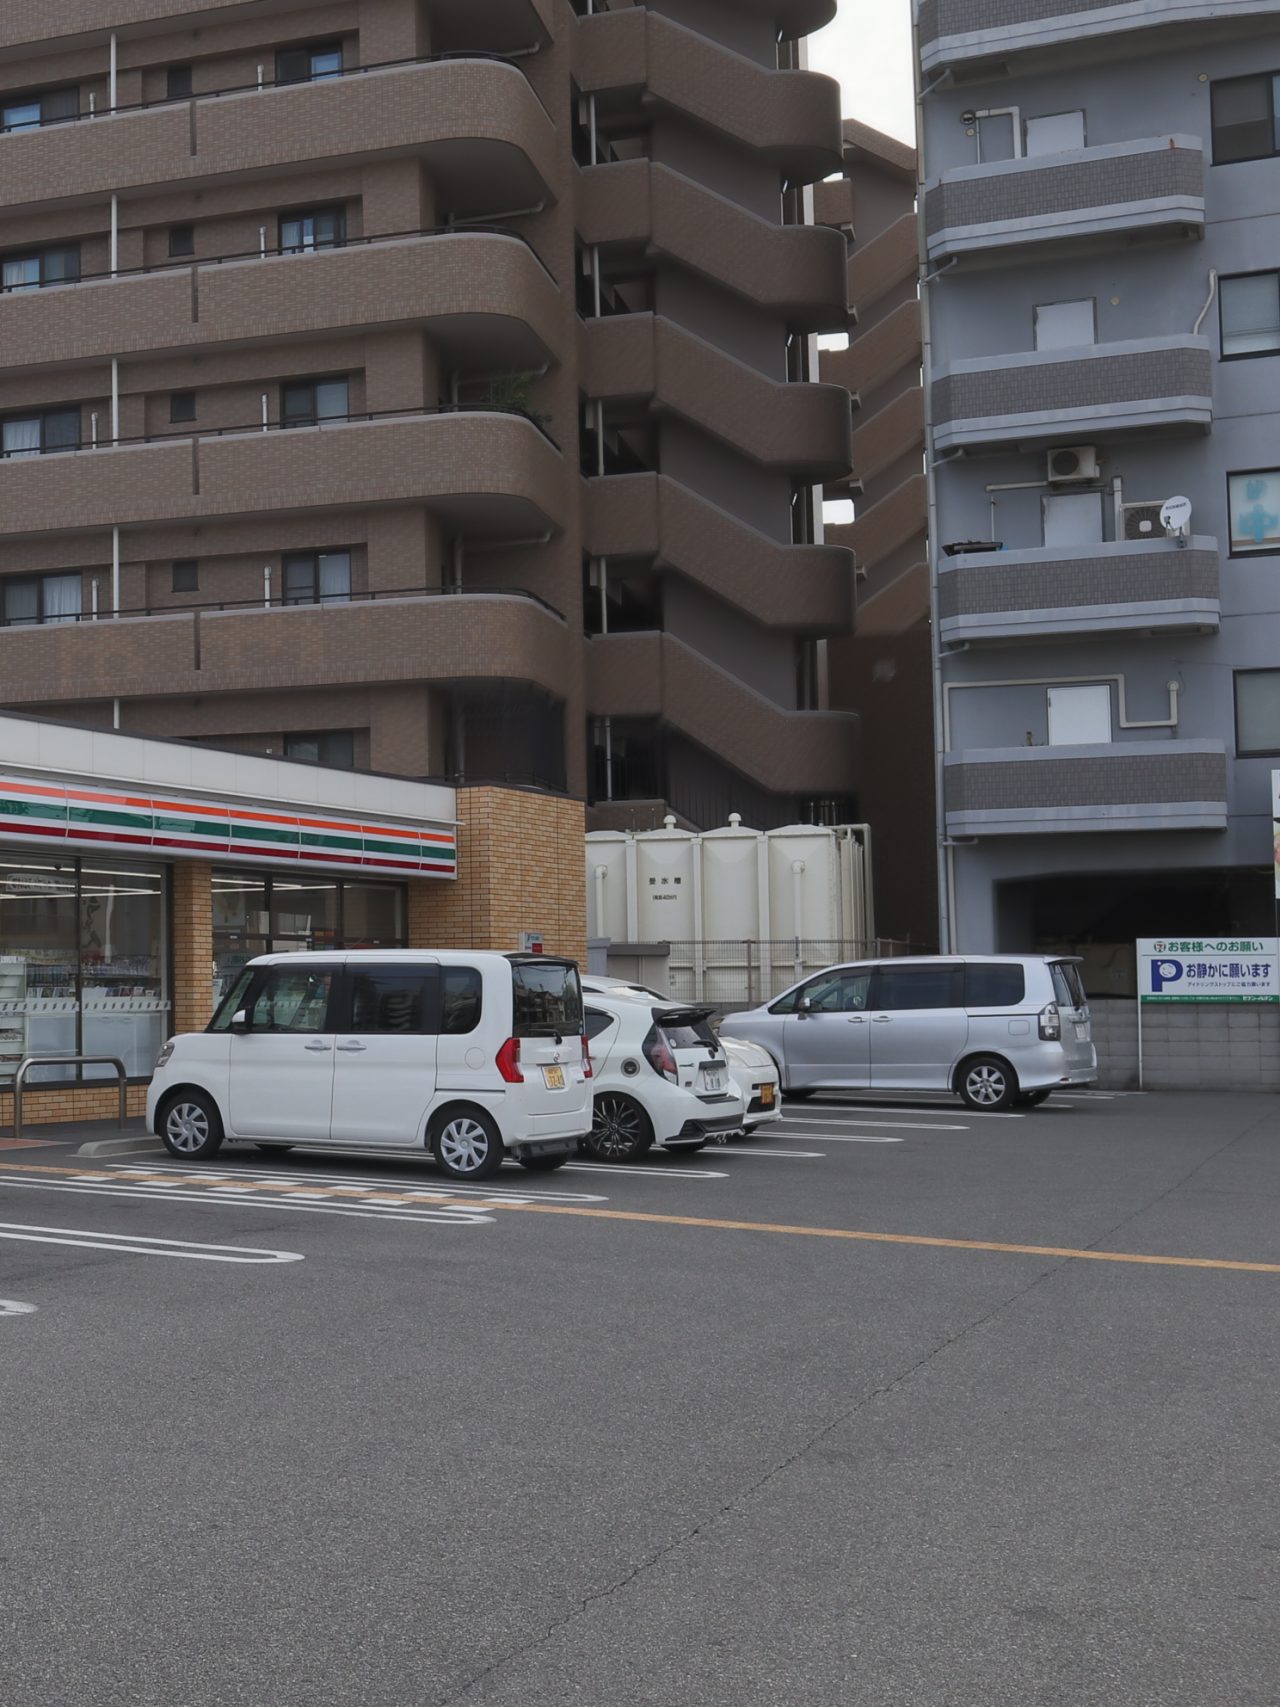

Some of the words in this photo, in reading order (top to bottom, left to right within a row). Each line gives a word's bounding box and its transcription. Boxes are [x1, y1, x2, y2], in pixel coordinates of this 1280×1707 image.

[1168, 941, 1264, 952] お客様へのお願い
[1151, 959, 1183, 992] P
[1186, 963, 1272, 979] お静かに願います
